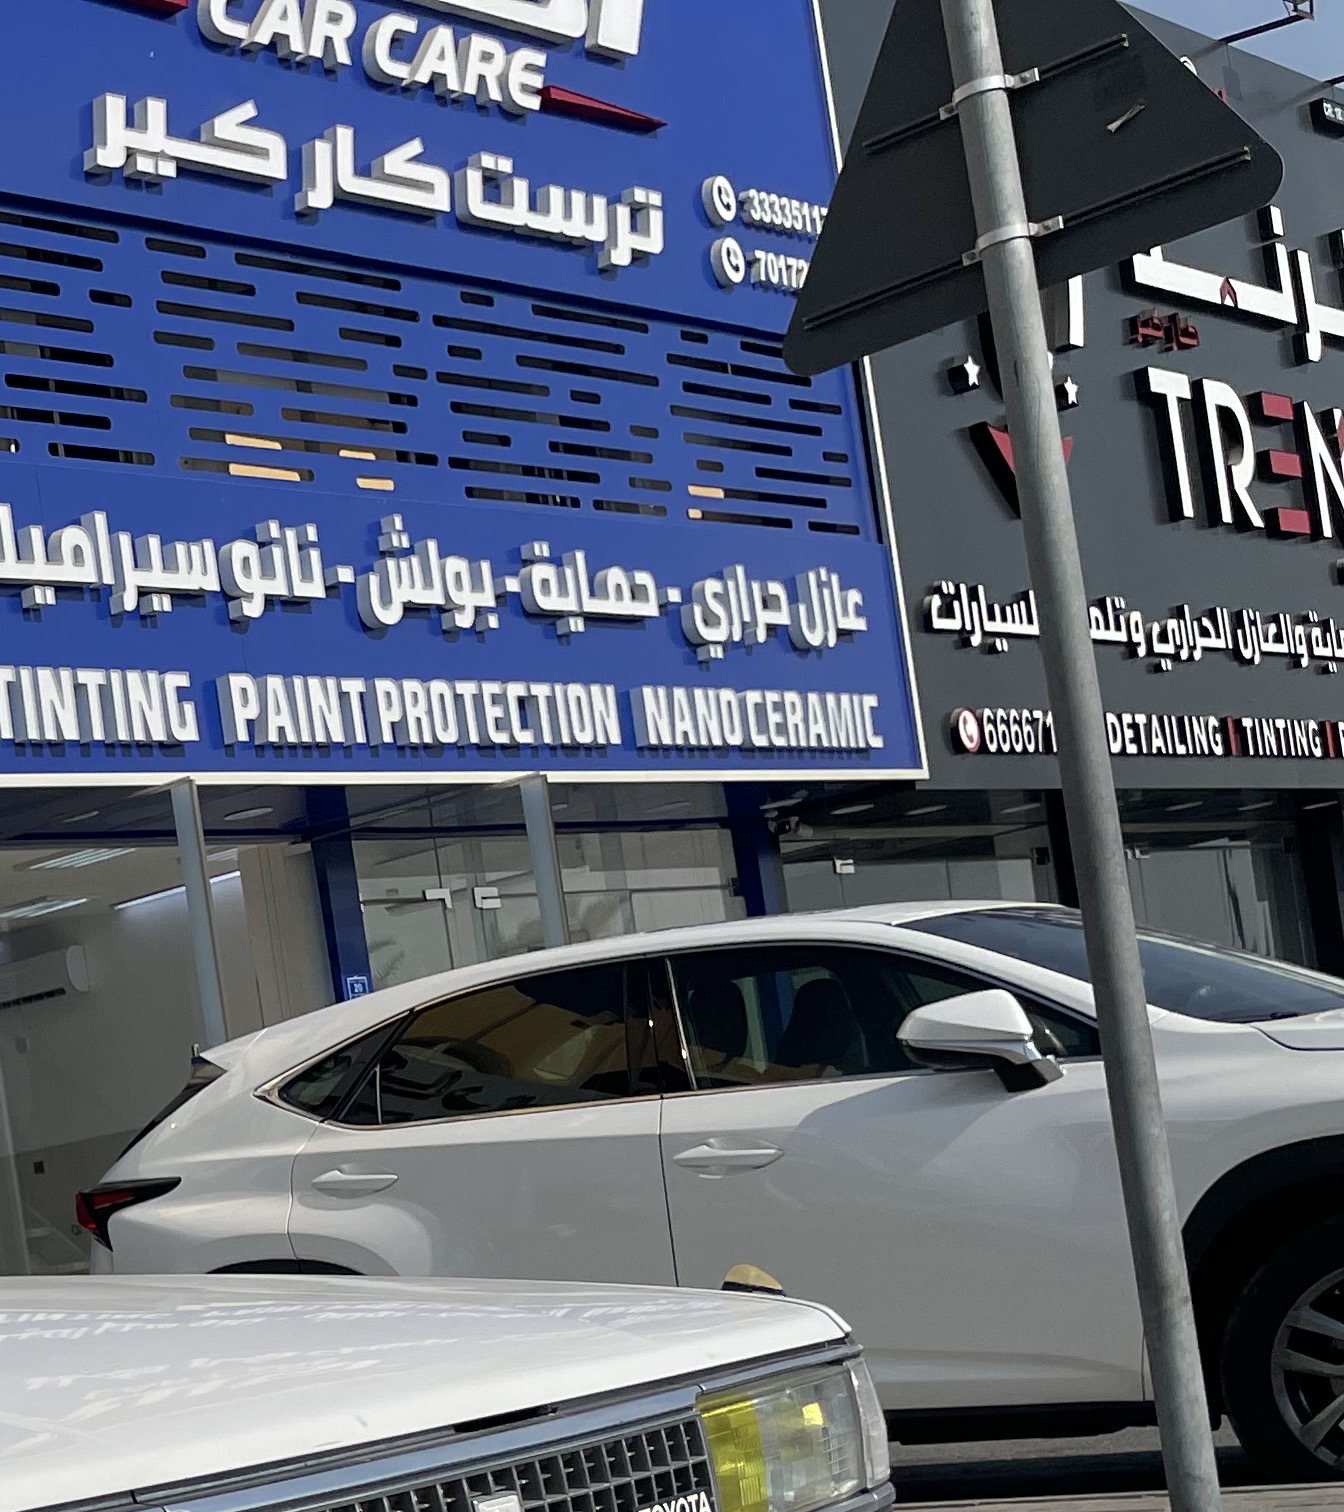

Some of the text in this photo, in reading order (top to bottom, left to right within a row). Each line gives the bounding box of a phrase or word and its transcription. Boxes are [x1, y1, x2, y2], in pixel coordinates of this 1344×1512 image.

[198, 0, 356, 68] CAR
[363, 13, 548, 112] CARE
[296, 125, 451, 213] كار
[454, 150, 665, 269] ترست
[219, 519, 327, 621] نانو
[519, 540, 660, 635] حماية
[681, 564, 792, 661] حراري
[789, 566, 868, 650] عازل
[1105, 712, 1224, 757] DETAILING
[1241, 716, 1322, 758] TINTING
